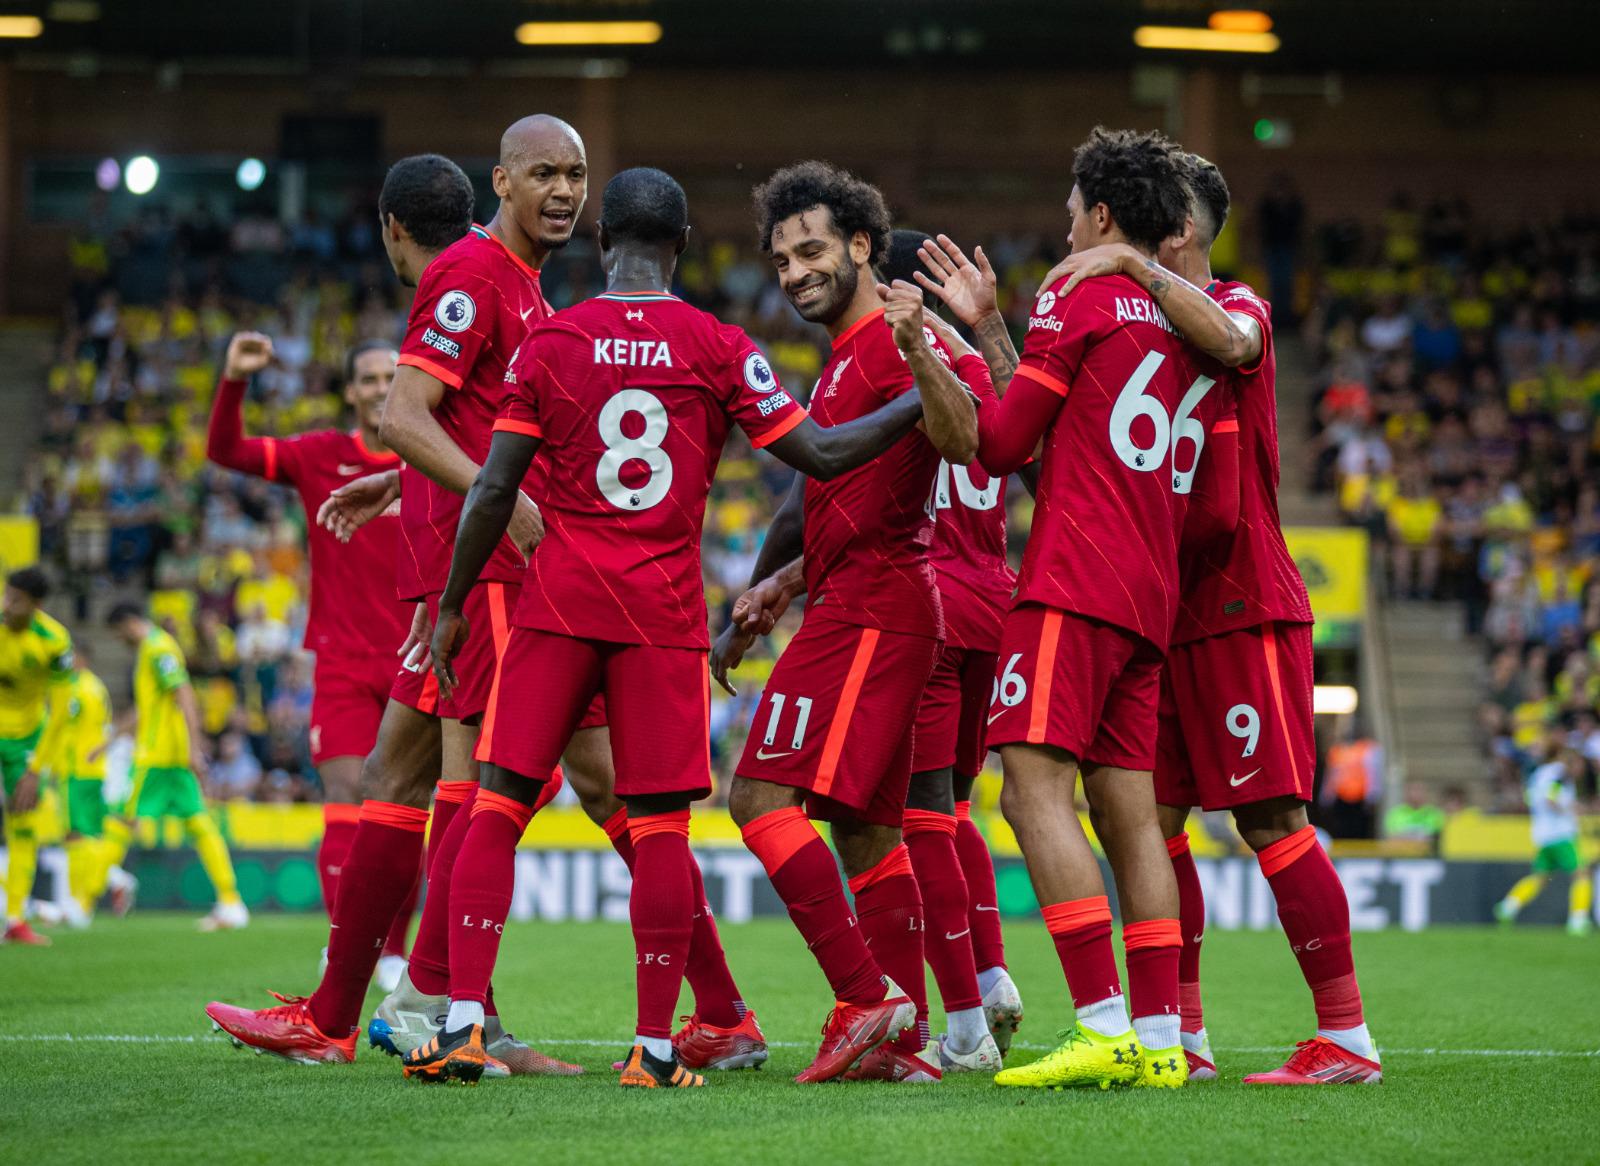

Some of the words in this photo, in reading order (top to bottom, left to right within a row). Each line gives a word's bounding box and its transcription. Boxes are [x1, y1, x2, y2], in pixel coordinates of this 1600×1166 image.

[437, 334, 460, 351] room
[1029, 314, 1064, 332] pedia
[1115, 296, 1185, 340] ALEXAN
[594, 338, 673, 368] KEITA
[1109, 349, 1217, 495] 66
[596, 388, 673, 511] 8
[764, 692, 813, 750] 11
[1225, 703, 1261, 758] 9
